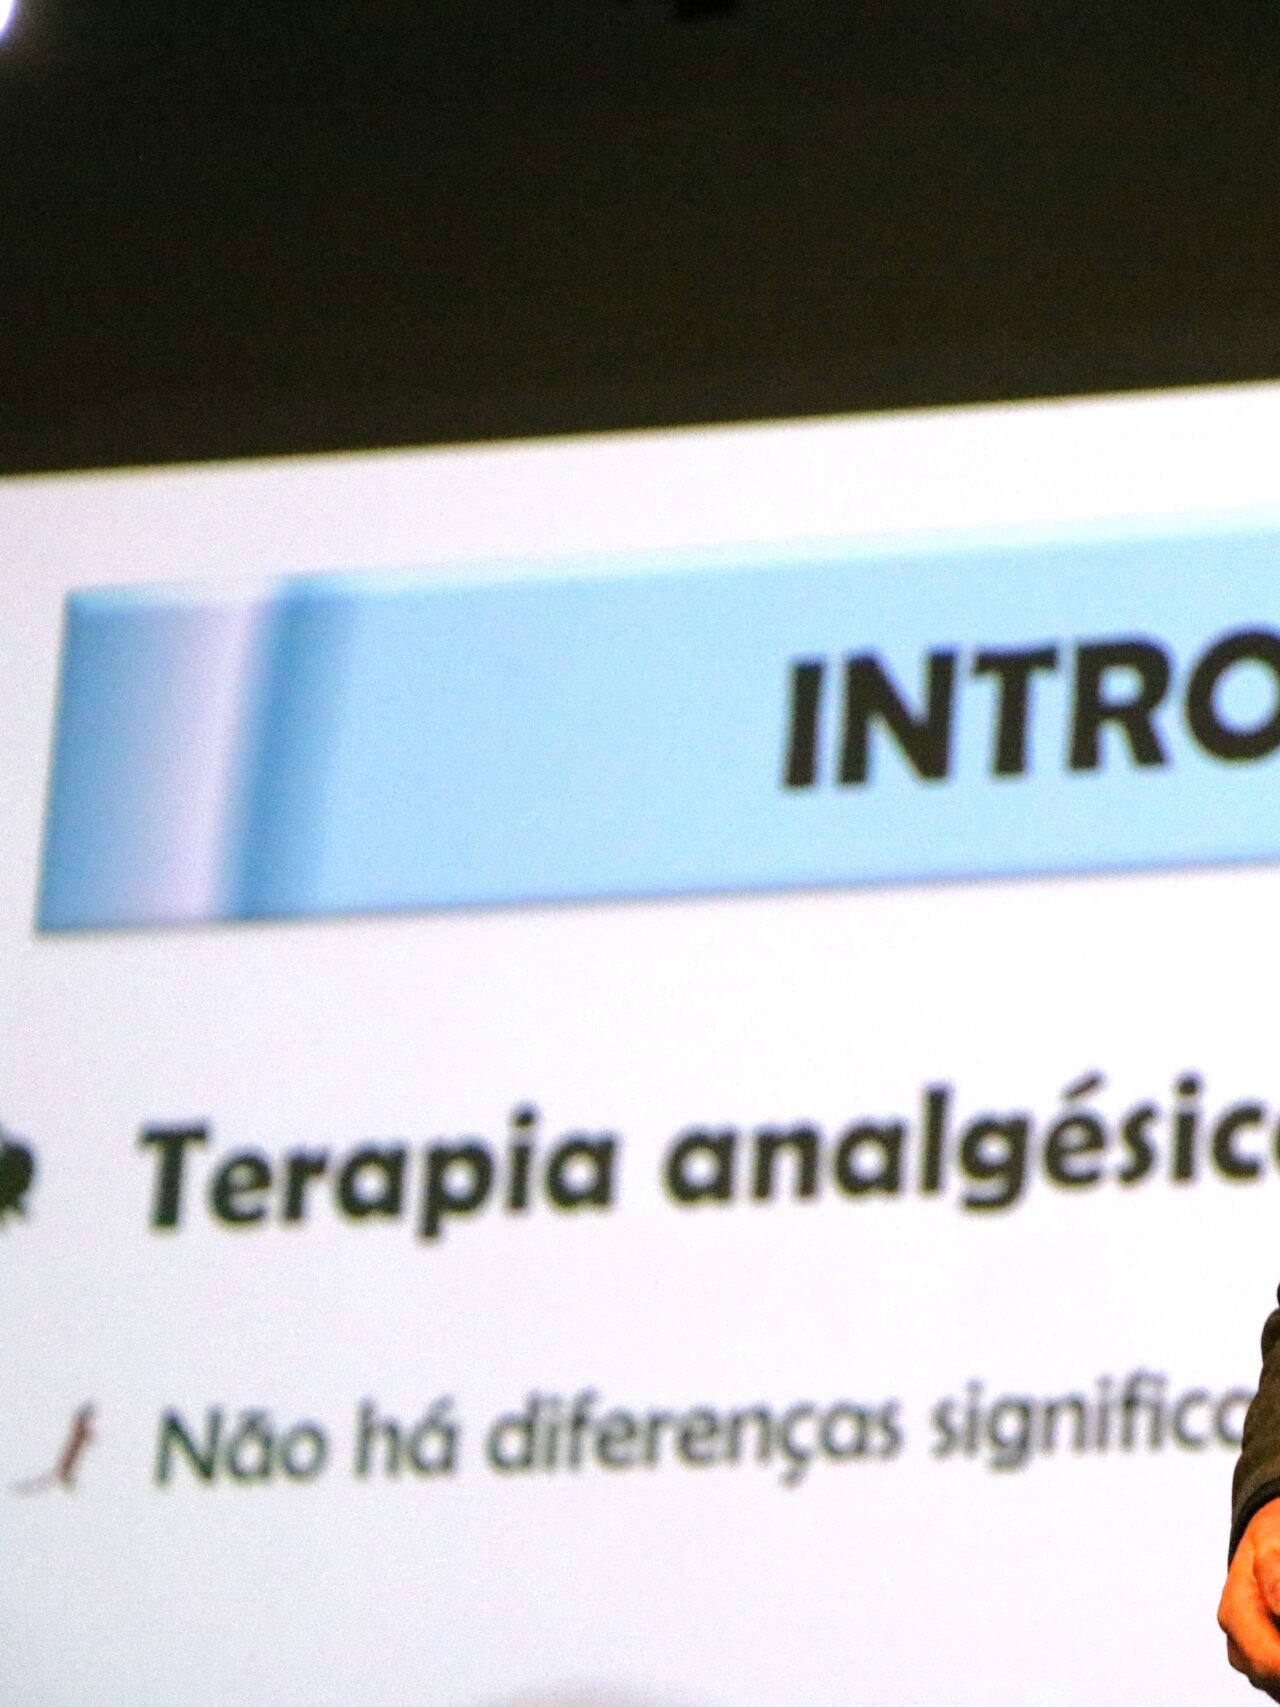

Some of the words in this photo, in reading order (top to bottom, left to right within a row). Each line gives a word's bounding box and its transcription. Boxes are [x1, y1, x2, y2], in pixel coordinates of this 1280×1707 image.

[137, 1101, 619, 1243] Terapia
[155, 1404, 328, 1487] Não
[353, 1394, 459, 1478] há
[486, 1386, 904, 1488] diferenças
